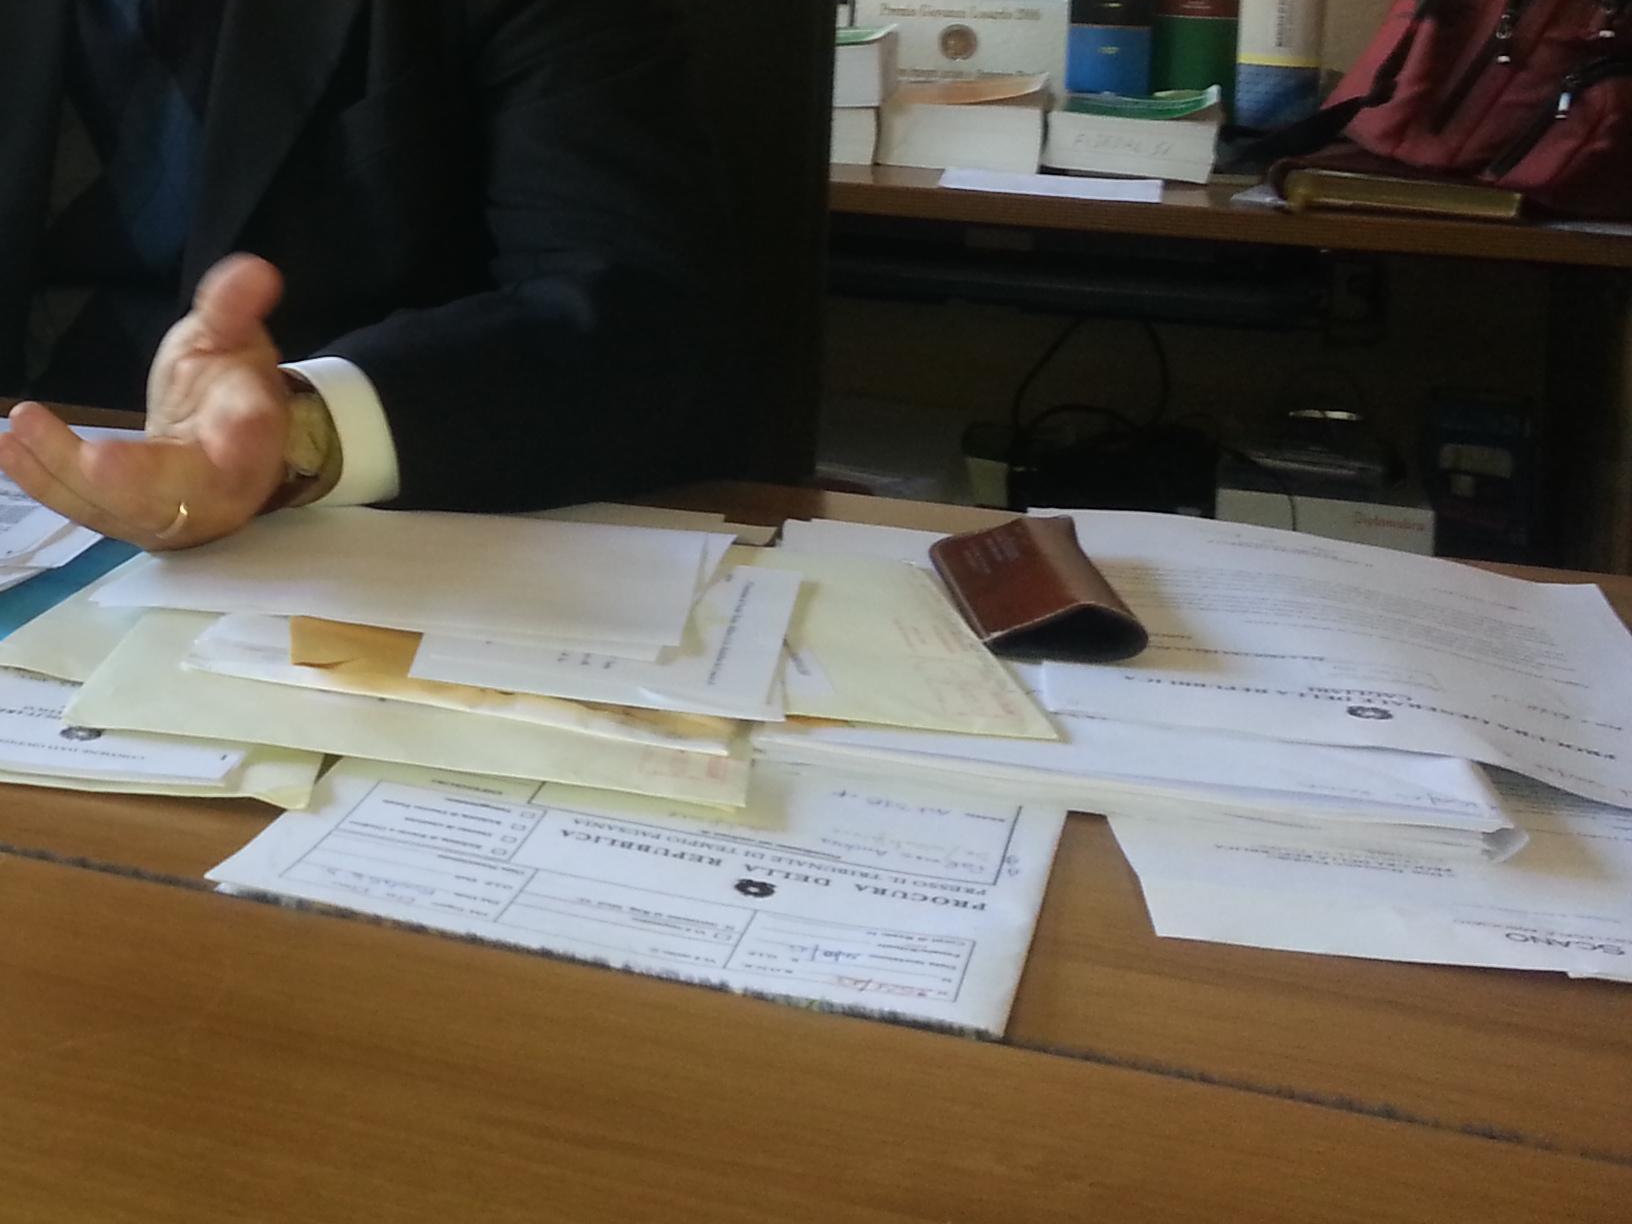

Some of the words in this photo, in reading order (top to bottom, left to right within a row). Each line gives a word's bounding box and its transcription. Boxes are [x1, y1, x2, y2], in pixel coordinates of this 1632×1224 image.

[574, 818, 662, 841] PAUSANIA
[561, 829, 722, 869] REPUBBLICA
[667, 836, 736, 855] TEMPIO
[744, 864, 831, 888] DELLA
[769, 856, 881, 881] TRIBUNALE
[854, 883, 986, 911] PROCURA
[912, 880, 986, 896] PRESSO
